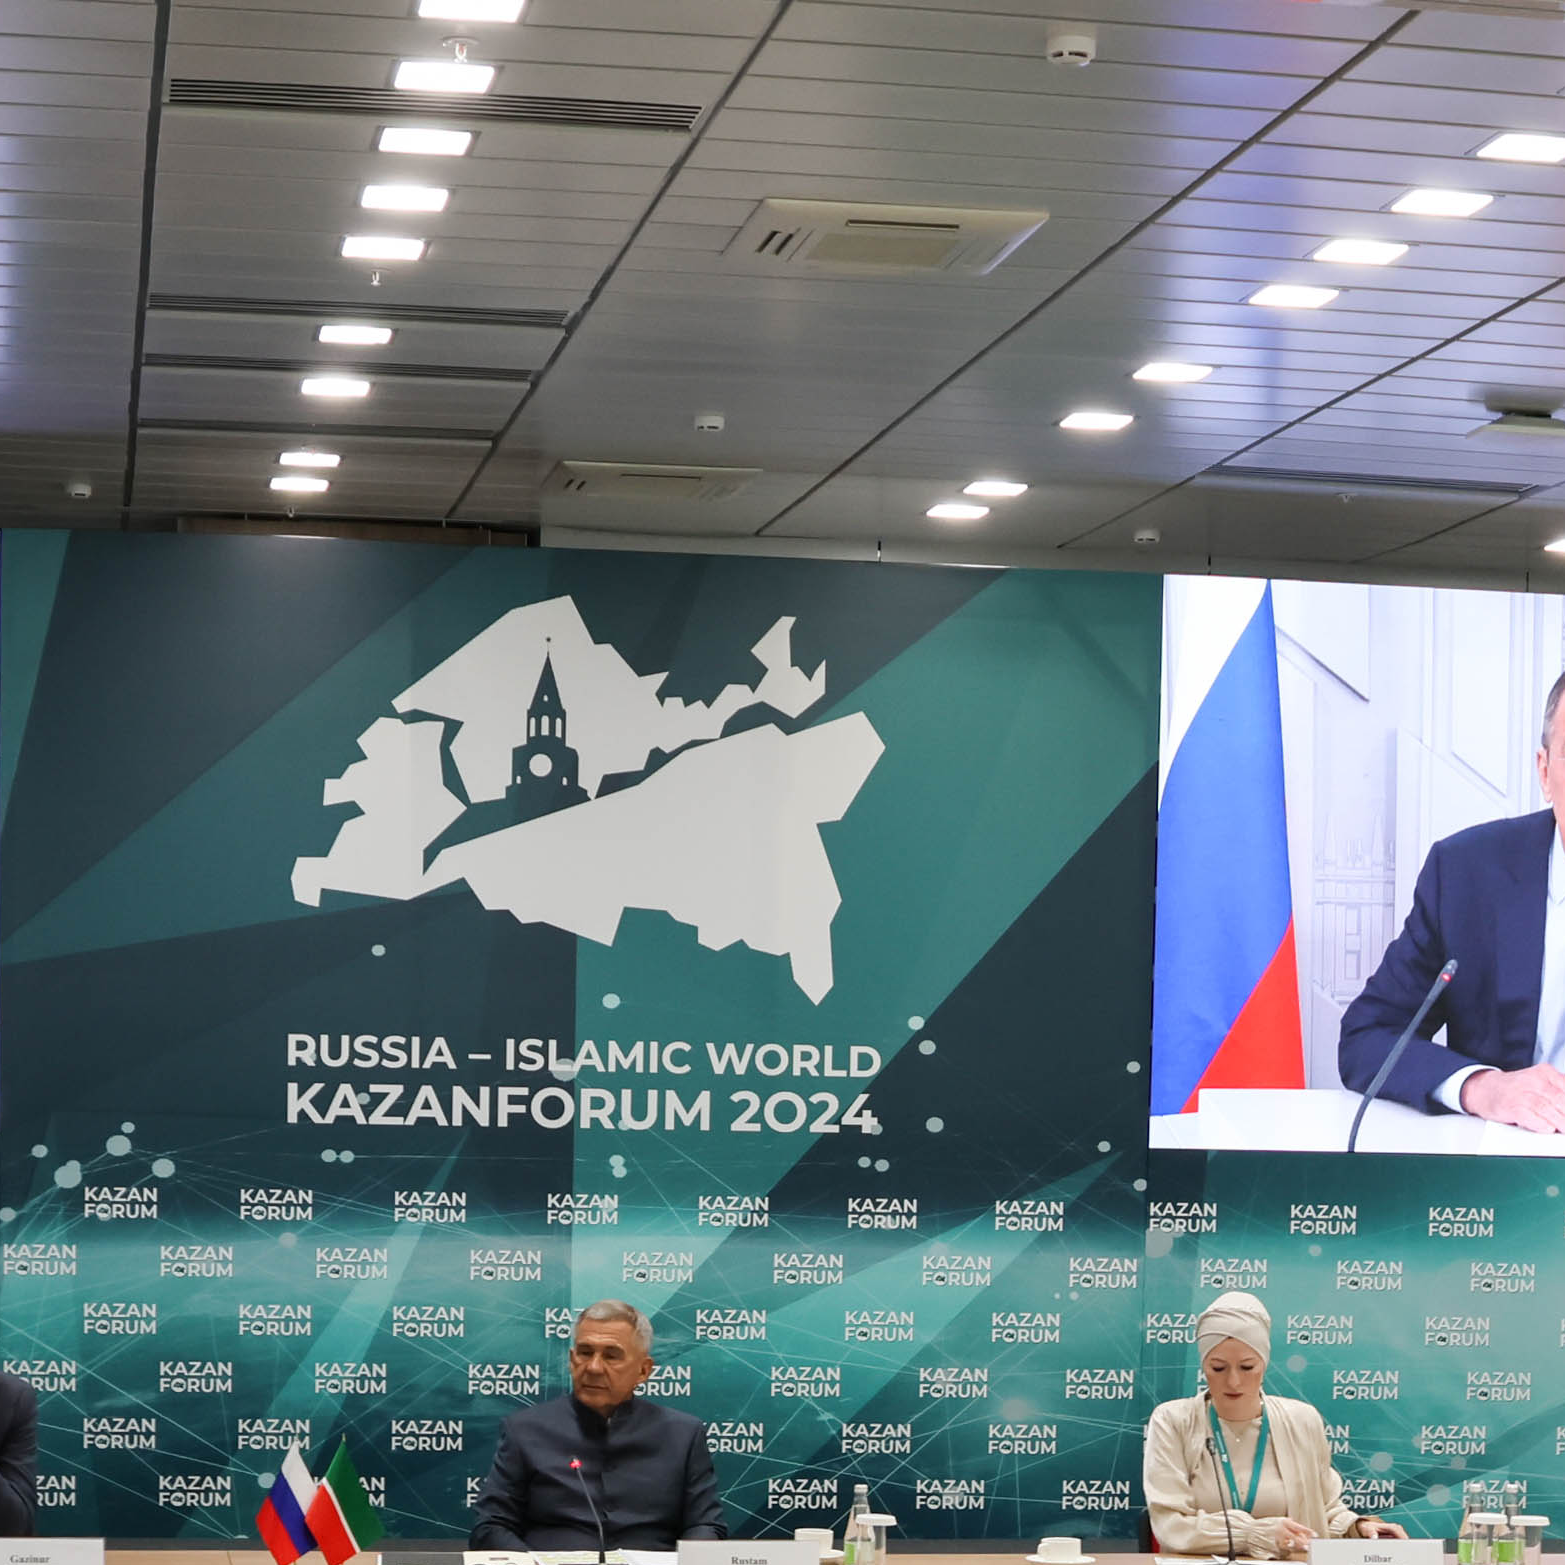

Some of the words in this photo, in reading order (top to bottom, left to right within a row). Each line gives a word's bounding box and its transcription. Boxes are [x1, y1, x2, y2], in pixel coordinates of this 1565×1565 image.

[288, 1034, 455, 1069] RUSSIA
[506, 1039, 691, 1075] ISLAMIC
[706, 1043, 881, 1077] WORLD
[288, 1082, 710, 1130] KAZANFORUM
[730, 1091, 881, 1134] 2024
[85, 1187, 157, 1201] KAZAN
[395, 1192, 466, 1206] KAZAN
[699, 1197, 768, 1210] KAZAN
[996, 1201, 1063, 1215] KAZAN
[85, 1204, 157, 1218] FORUM
[395, 1208, 465, 1222] FORUM
[1291, 1205, 1356, 1218] KAZAN
[699, 1213, 768, 1226] FORUM
[996, 1217, 1063, 1231] FORUM
[1291, 1221, 1355, 1234] FORUM
[161, 1246, 232, 1260] KAZAN
[471, 1251, 540, 1267] KAZAN
[774, 1254, 842, 1267] KAZAN
[1070, 1258, 1137, 1272] KAZAN
[161, 1263, 232, 1276] FORUM
[471, 1267, 540, 1280] FORUM
[1338, 1261, 1402, 1277] KAZAN
[774, 1270, 842, 1284] FORUM
[1070, 1274, 1136, 1287] FORUM
[1337, 1276, 1401, 1289] FORUM
[84, 1304, 156, 1317] KAZAN
[393, 1307, 463, 1320] KAZAN
[846, 1312, 913, 1324] KAZAN
[1288, 1316, 1352, 1328] KAZAN
[84, 1320, 155, 1334] FORUM
[393, 1323, 463, 1337] FORUM
[845, 1327, 912, 1340] FORUM
[1287, 1331, 1351, 1344] FORUM
[316, 1363, 386, 1380] KAZAN
[771, 1367, 840, 1380] KAZAN
[1067, 1370, 1133, 1383] KAZAN
[316, 1380, 386, 1393] FORUM
[1468, 1372, 1530, 1388] KAZAN
[771, 1383, 839, 1396] FORUM
[1066, 1385, 1132, 1399] FORUM
[1467, 1387, 1530, 1400] FORUM
[392, 1421, 462, 1434] KAZAN
[989, 1425, 1056, 1438] KAZAN
[392, 1437, 462, 1450] FORUM
[989, 1441, 1055, 1454] FORUM
[160, 1476, 230, 1490] KAZAN
[769, 1479, 837, 1492] KAZAN
[917, 1480, 984, 1493] KAZAN
[1063, 1481, 1129, 1497] KAZAN
[159, 1493, 230, 1506] FORUM
[769, 1495, 836, 1508] FORUM
[917, 1496, 984, 1509] FORUM
[1062, 1496, 1129, 1510] FORUM
[731, 1556, 768, 1565] Rustam
